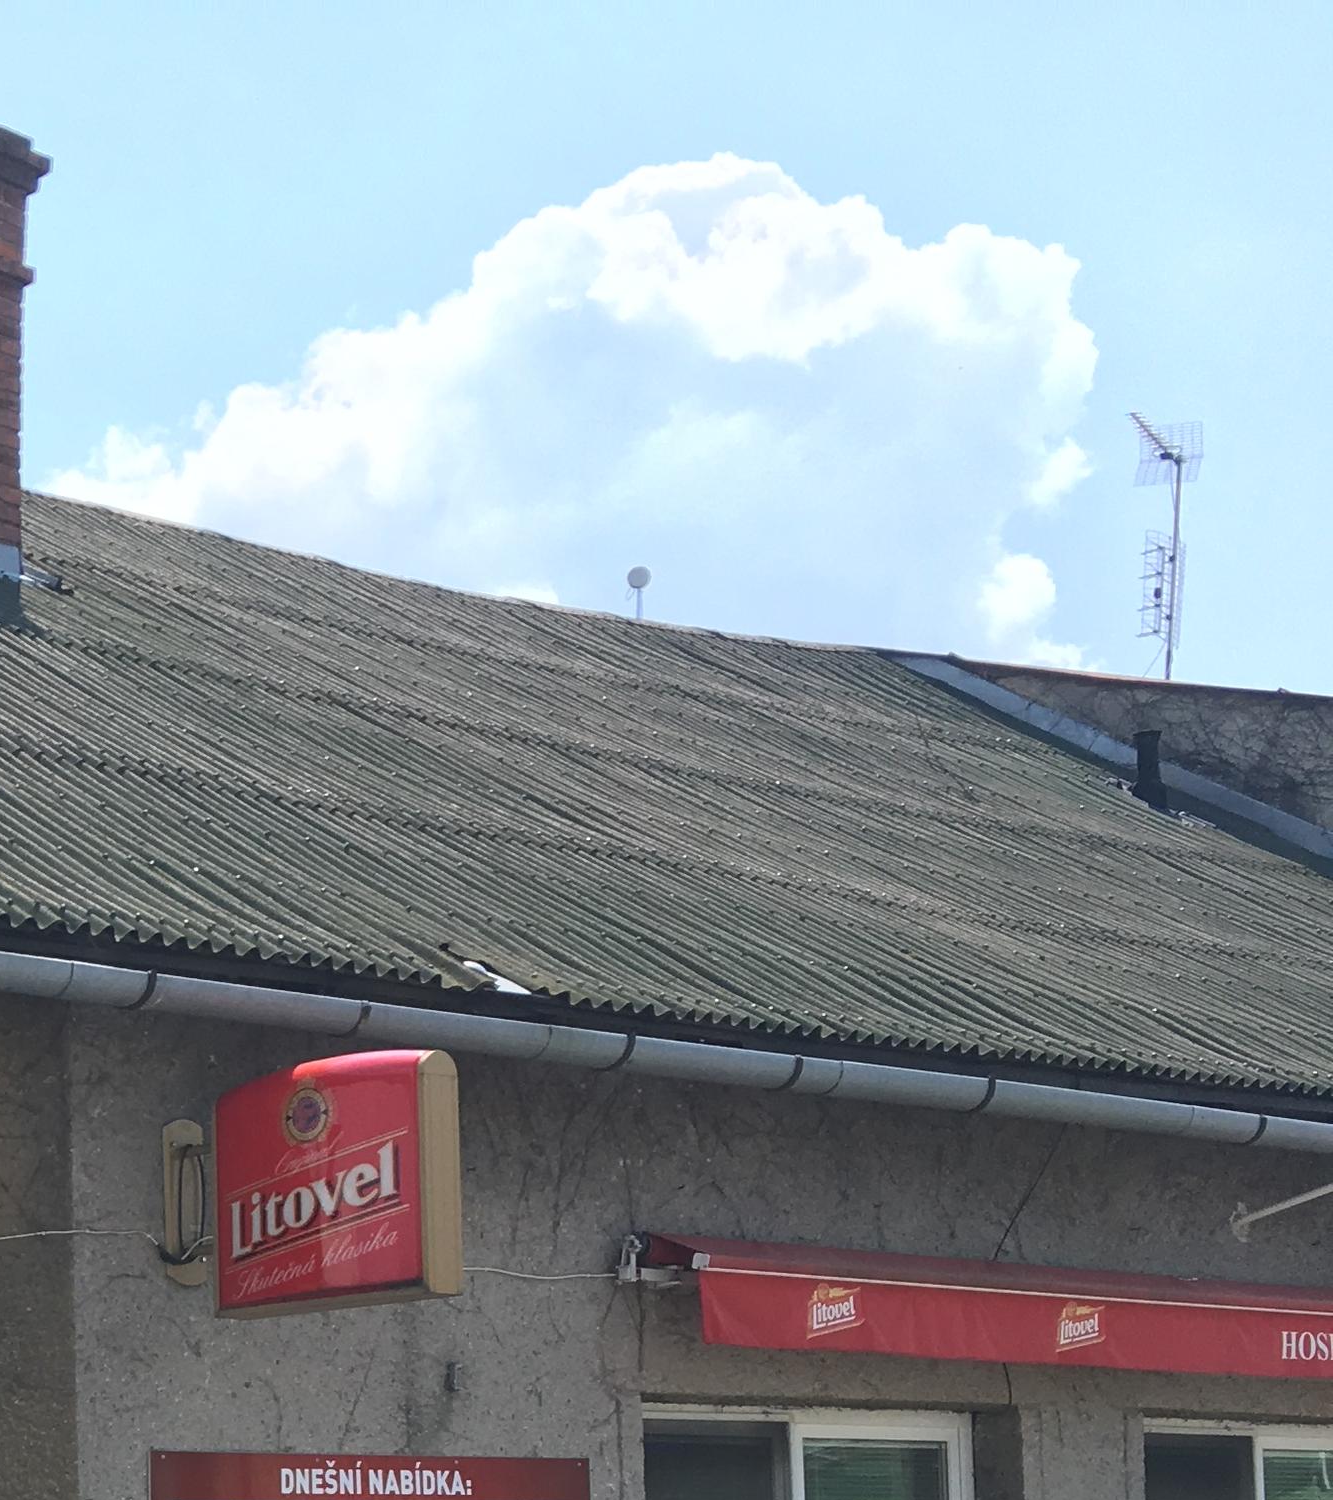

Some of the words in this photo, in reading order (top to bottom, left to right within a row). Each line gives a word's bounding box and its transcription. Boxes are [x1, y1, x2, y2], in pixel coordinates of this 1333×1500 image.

[231, 1140, 398, 1260] Litovel
[321, 1222, 398, 1267] klasika
[813, 1295, 856, 1330] Litovel
[1060, 1313, 1099, 1345] Litovel
[280, 1460, 362, 1495] DNEŠNÍ
[368, 1462, 472, 1496] NABÍDKA:
